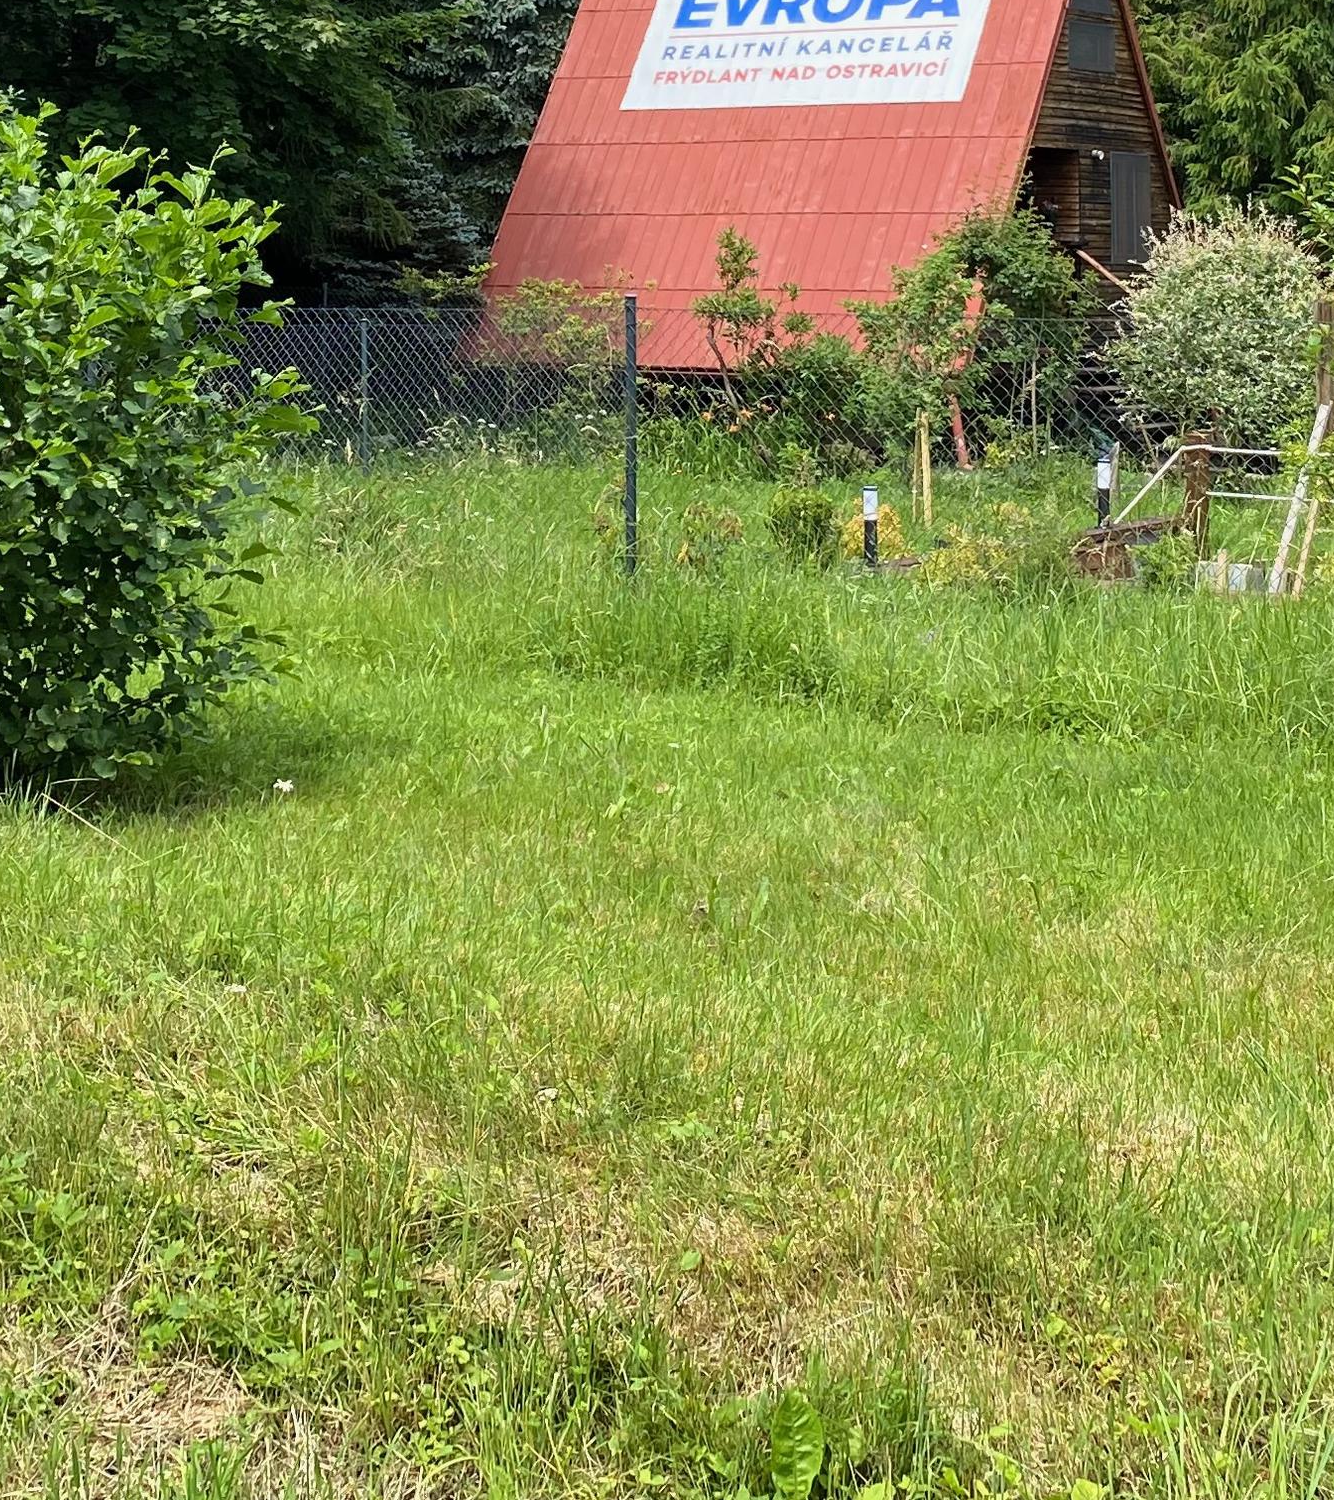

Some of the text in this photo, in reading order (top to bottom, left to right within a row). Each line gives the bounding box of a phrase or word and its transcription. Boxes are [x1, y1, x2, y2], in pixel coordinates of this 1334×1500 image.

[662, 31, 954, 61] REALITNÍ KANCELÁŘ
[653, 58, 949, 85] FRÝDLANT NAD OSTRAVICÍ
